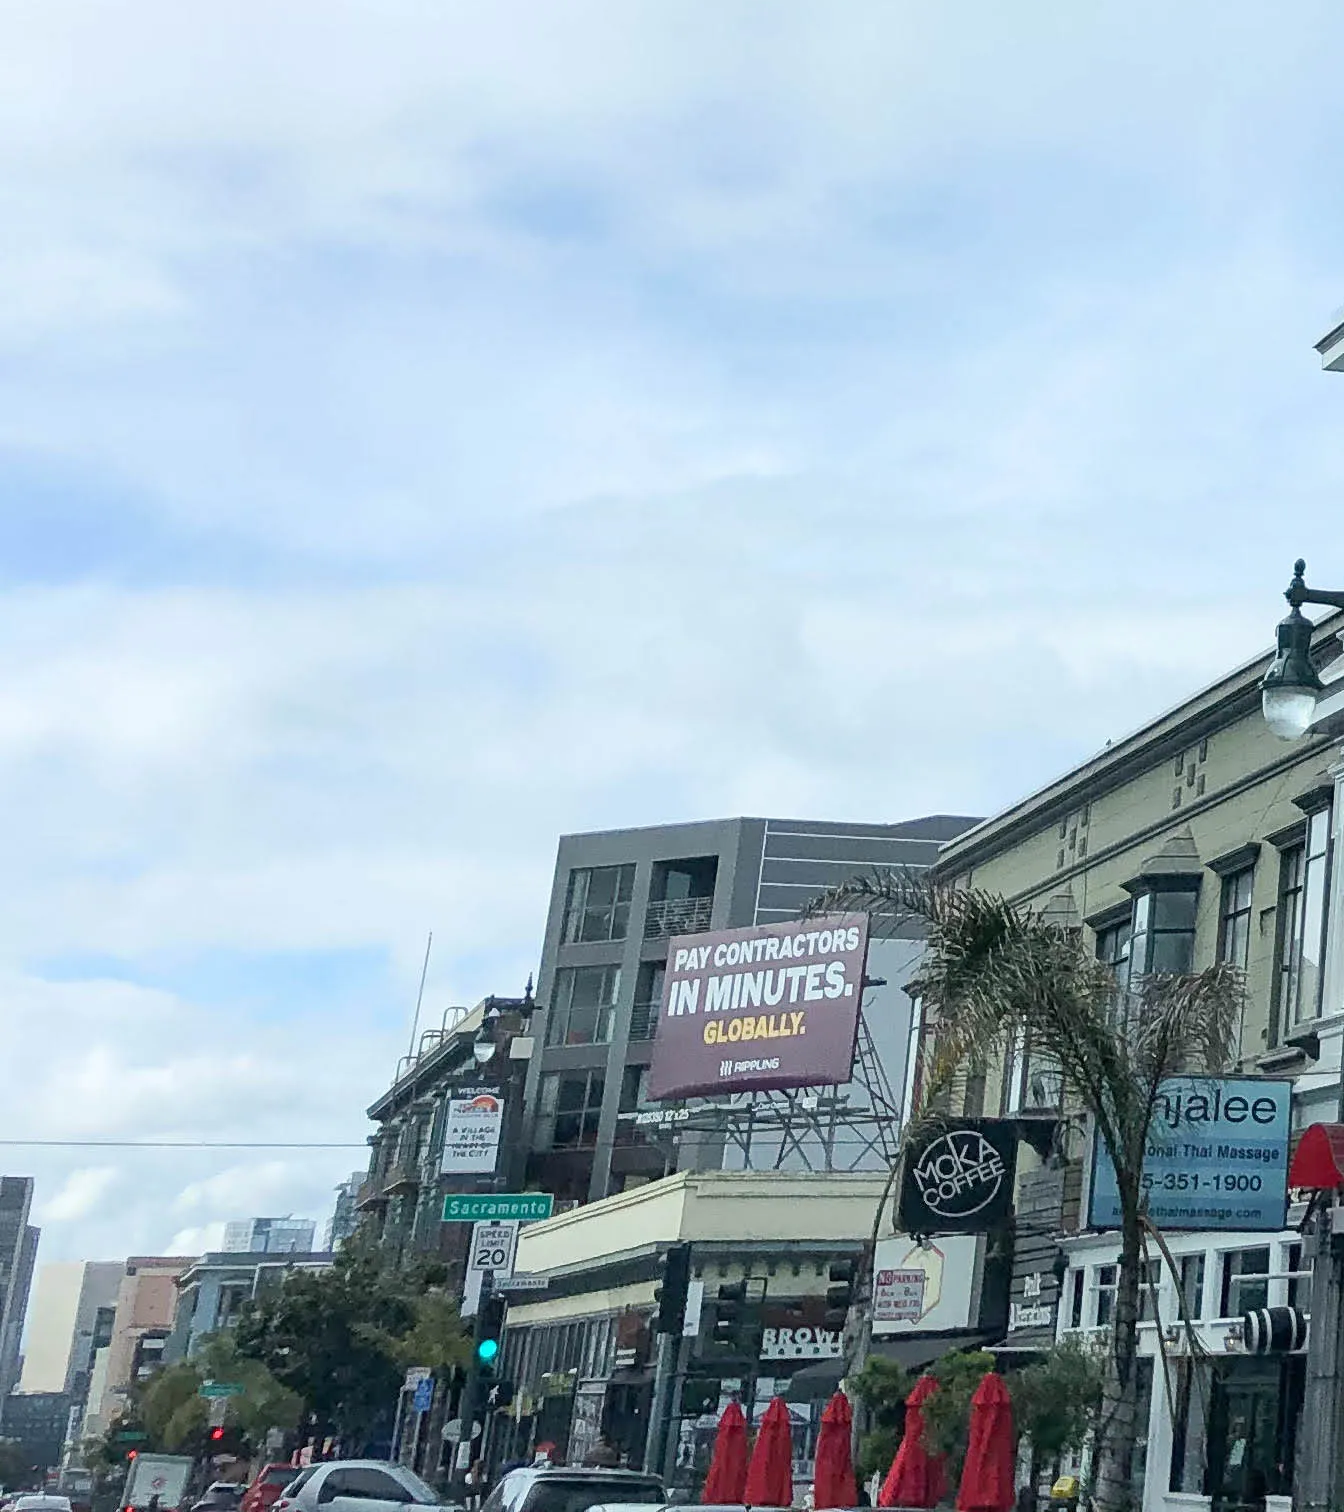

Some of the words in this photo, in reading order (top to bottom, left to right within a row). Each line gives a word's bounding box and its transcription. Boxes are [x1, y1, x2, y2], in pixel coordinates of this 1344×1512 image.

[674, 945, 712, 972] PAY
[714, 927, 859, 967] CONTRACTORS
[667, 978, 700, 1017] IN
[704, 961, 853, 1013] MINUTES.
[703, 1011, 806, 1045] GLOBALLY.
[733, 1058, 780, 1073] RIPPLING
[1151, 1089, 1277, 1129] njalee
[1183, 1144, 1213, 1158] Thai
[1217, 1145, 1279, 1162] Massage
[913, 1136, 1000, 1191] MOKA
[923, 1161, 1007, 1206] COFFEE
[1142, 1173, 1262, 1191] 5-351-1900
[449, 1199, 546, 1215] Sacramento
[480, 1230, 510, 1239] SPEED
[481, 1239, 505, 1247] LIMIT
[476, 1249, 506, 1266] 20
